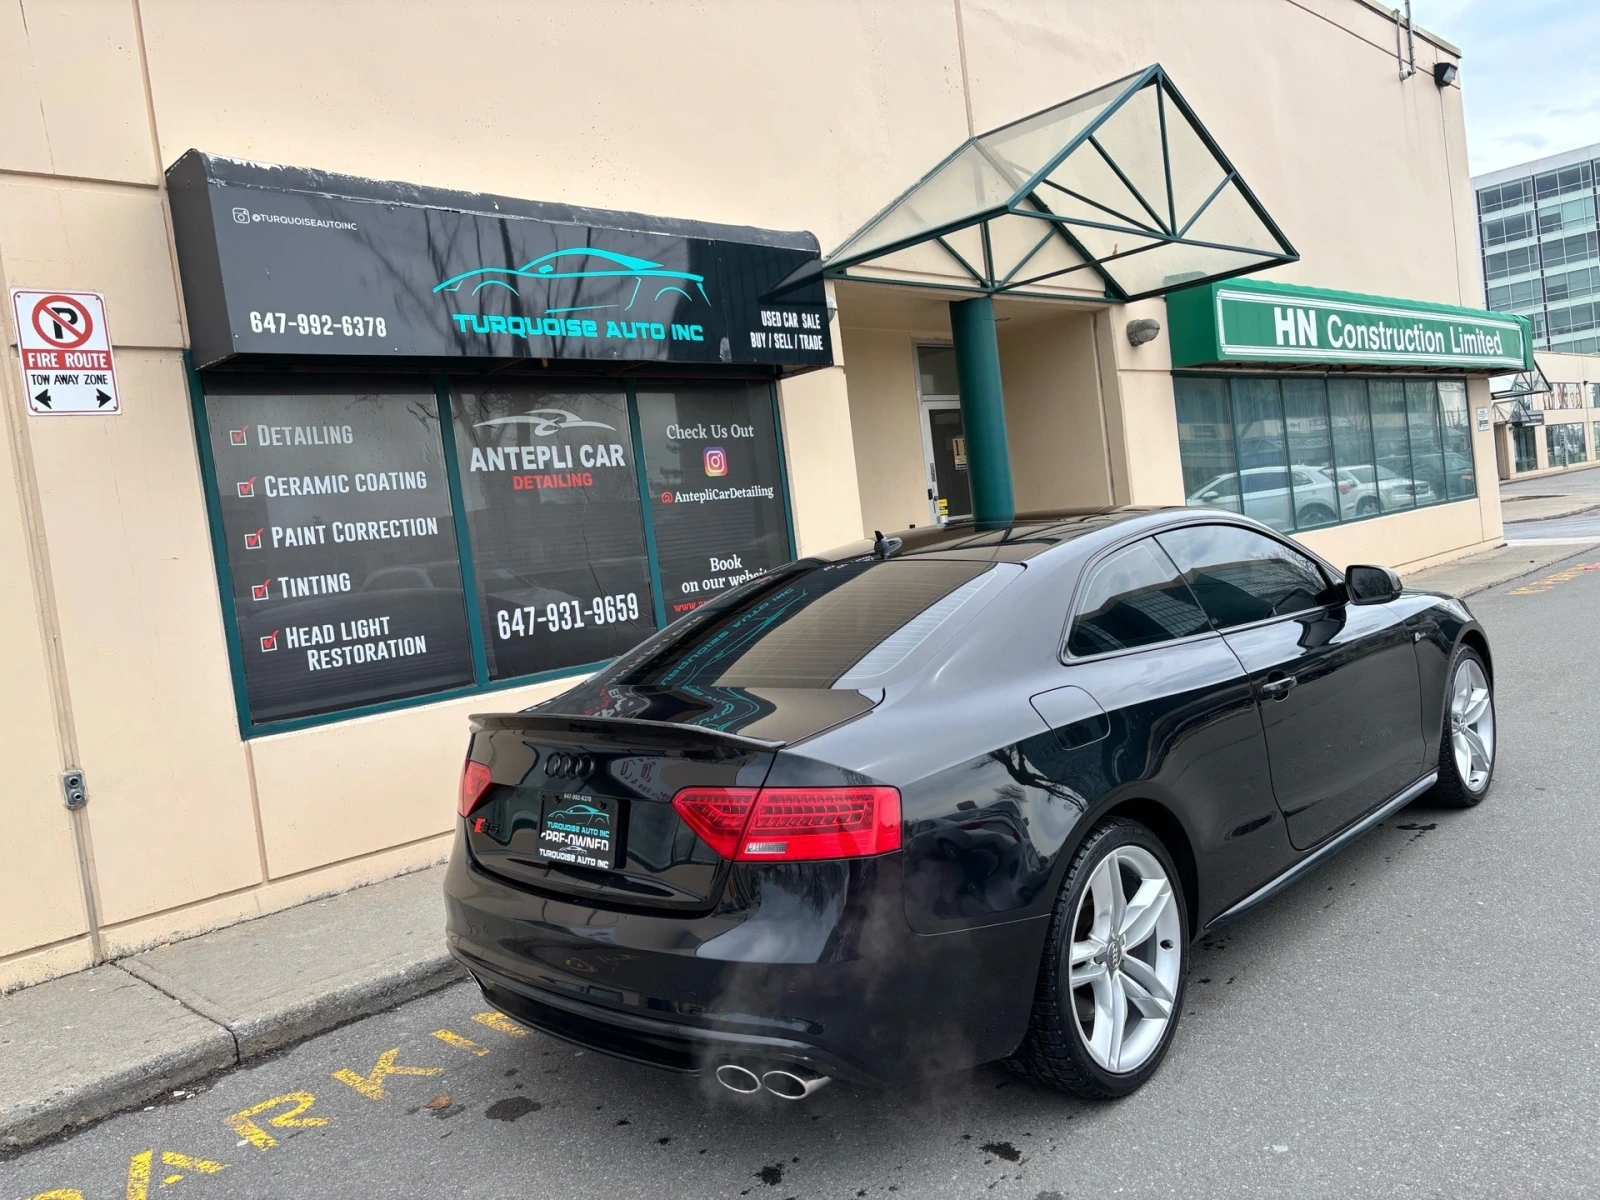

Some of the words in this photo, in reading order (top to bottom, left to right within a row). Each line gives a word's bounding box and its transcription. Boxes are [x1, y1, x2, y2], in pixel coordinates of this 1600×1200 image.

[252, 213, 357, 230] @TURQUOISEAUTOINC
[249, 311, 388, 338] 647-992-6378
[761, 310, 782, 327] USED
[783, 312, 799, 328] CAR
[802, 313, 820, 329] SALE
[606, 323, 666, 341] AUTO
[672, 325, 704, 342] INC
[1273, 306, 1318, 347] HN
[1327, 313, 1445, 354] Construction
[1450, 325, 1503, 356] Limited
[750, 332, 767, 349] BUY
[774, 333, 793, 350] SELL
[799, 334, 823, 351] TRADE
[27, 351, 59, 369] FIRE
[64, 351, 109, 369] ROUTE
[31, 374, 51, 385] TOW
[53, 374, 80, 386] AWAY
[84, 373, 109, 386] ZONE
[257, 425, 354, 447] DETAILING
[666, 424, 707, 440] Check
[710, 424, 728, 439] Us
[730, 424, 754, 438] Out
[469, 445, 573, 472] ANTEPLI
[579, 444, 626, 468] CAR
[264, 474, 350, 498] CERAMIC
[355, 470, 428, 493] COATING
[512, 472, 593, 490] DETAILING
[271, 525, 326, 549] PAINT
[332, 517, 439, 543] CORRECTION
[709, 555, 743, 572] Book
[278, 572, 352, 599] TINTING
[681, 581, 700, 594] on
[702, 576, 726, 591] our
[496, 592, 639, 640] 647-931-9659
[285, 623, 336, 649] HEAD
[340, 616, 391, 641] LIGHT
[307, 635, 427, 671] RESTORATION
[581, 827, 598, 836] AUTO
[599, 829, 610, 838] INC
[576, 856, 596, 867] AUTO
[597, 859, 610, 869] INC
